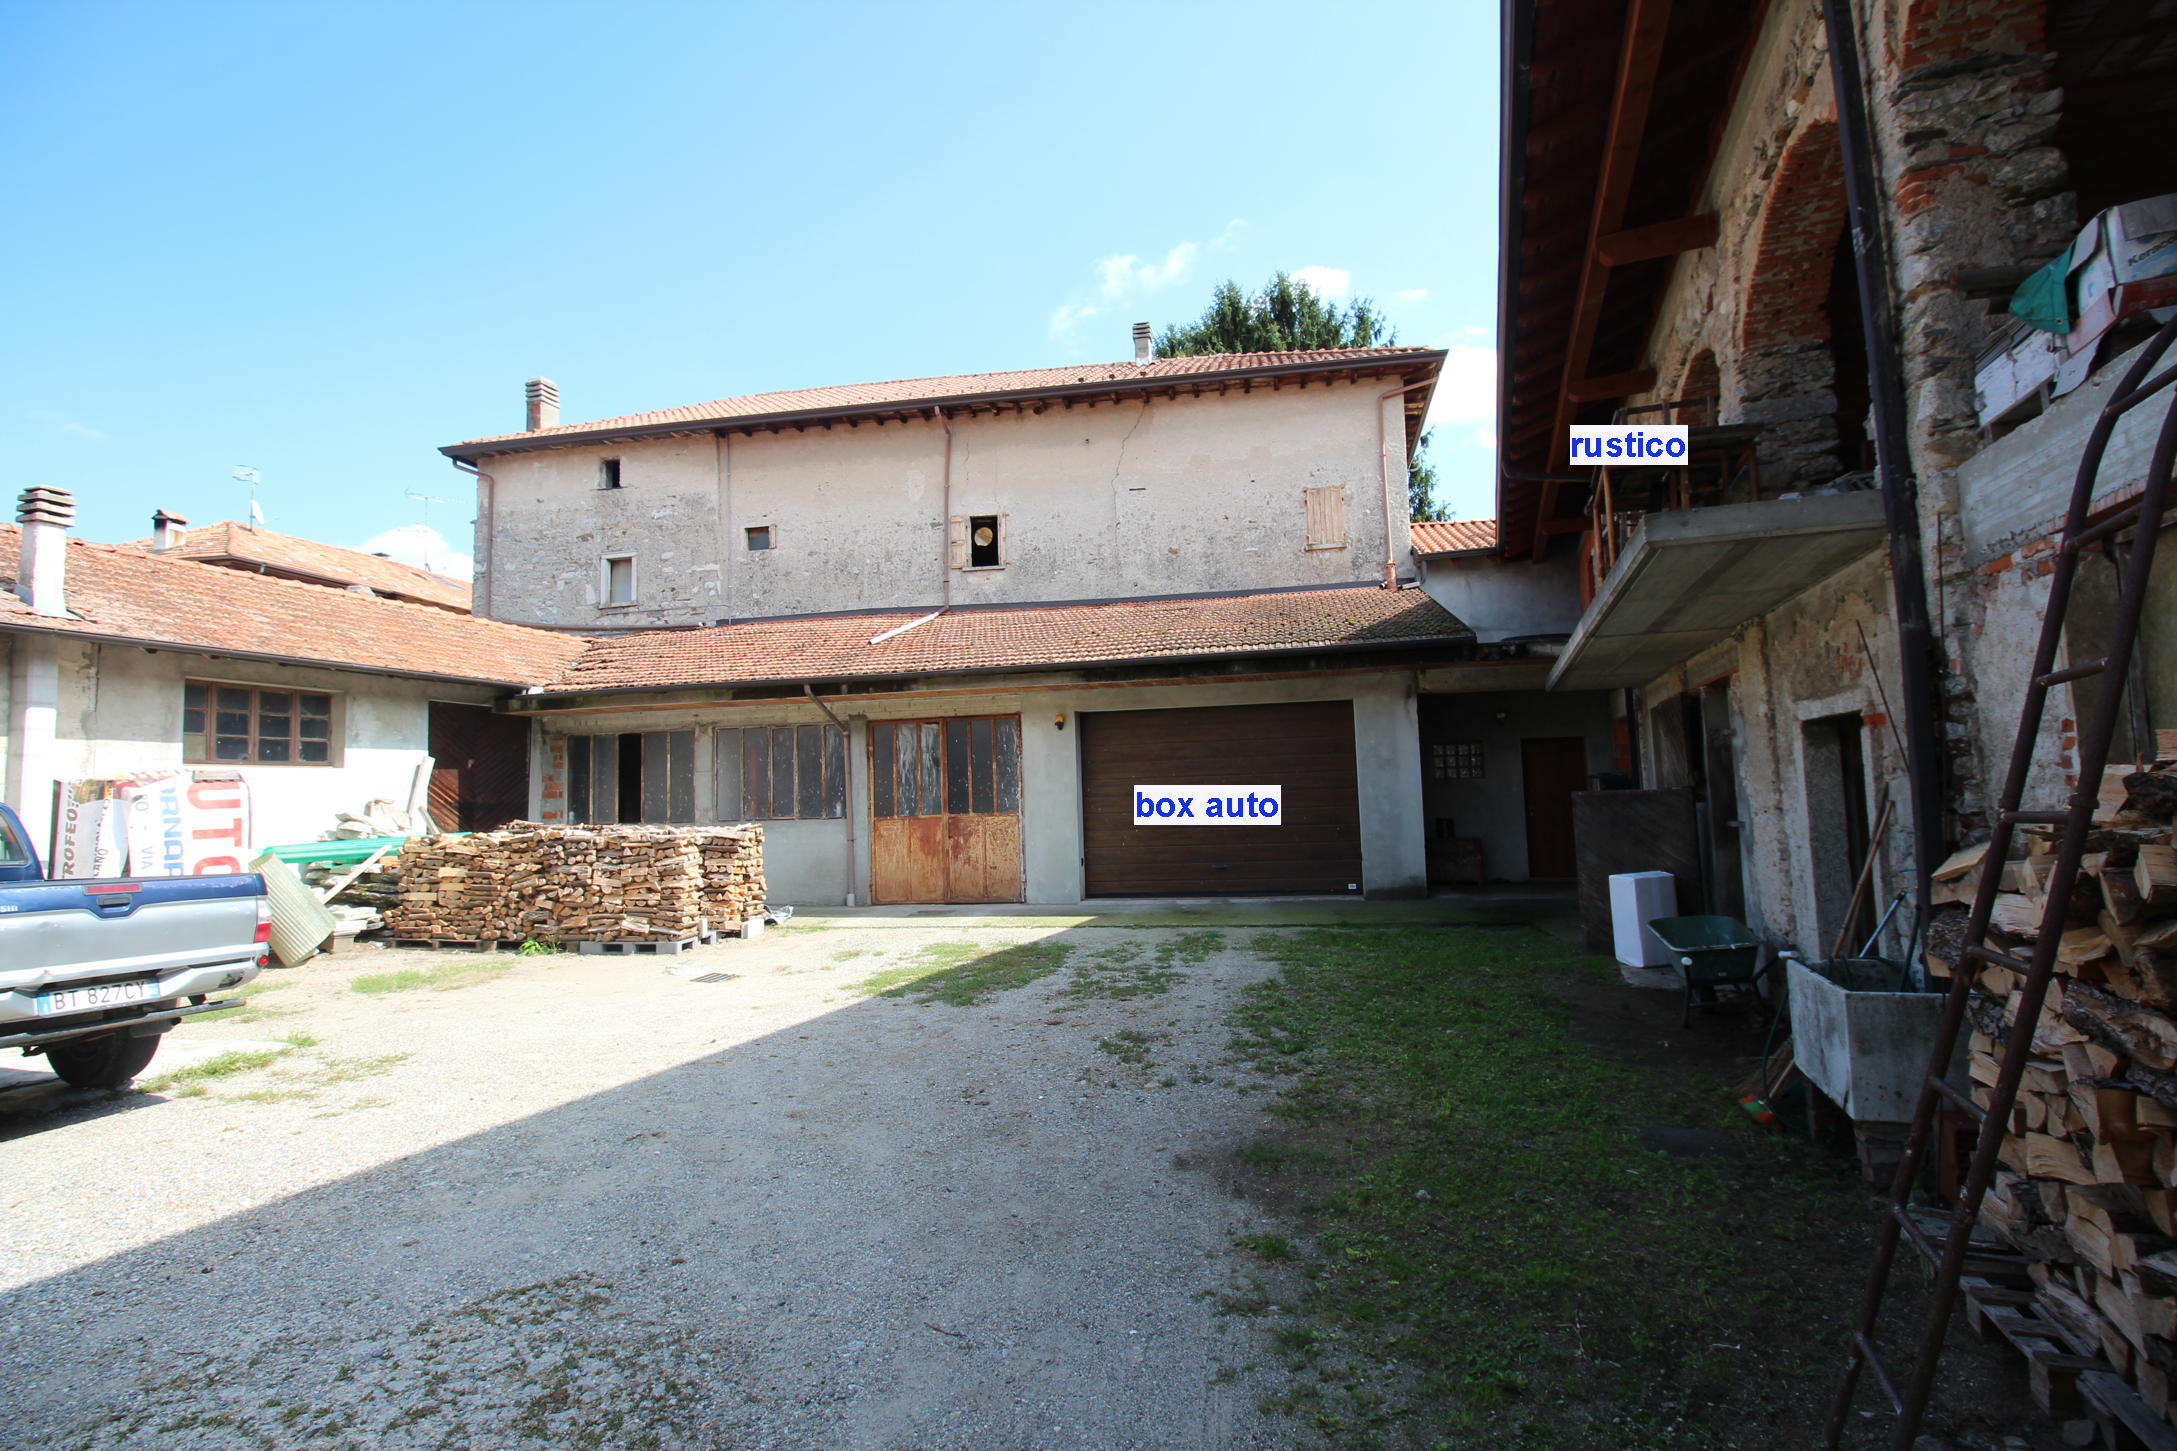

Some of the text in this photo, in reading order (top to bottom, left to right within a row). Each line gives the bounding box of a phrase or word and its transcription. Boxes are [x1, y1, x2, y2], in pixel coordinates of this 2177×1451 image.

[140, 846, 154, 870] VIA
[54, 990, 81, 1009] BT
[87, 981, 146, 1005] 827CY
